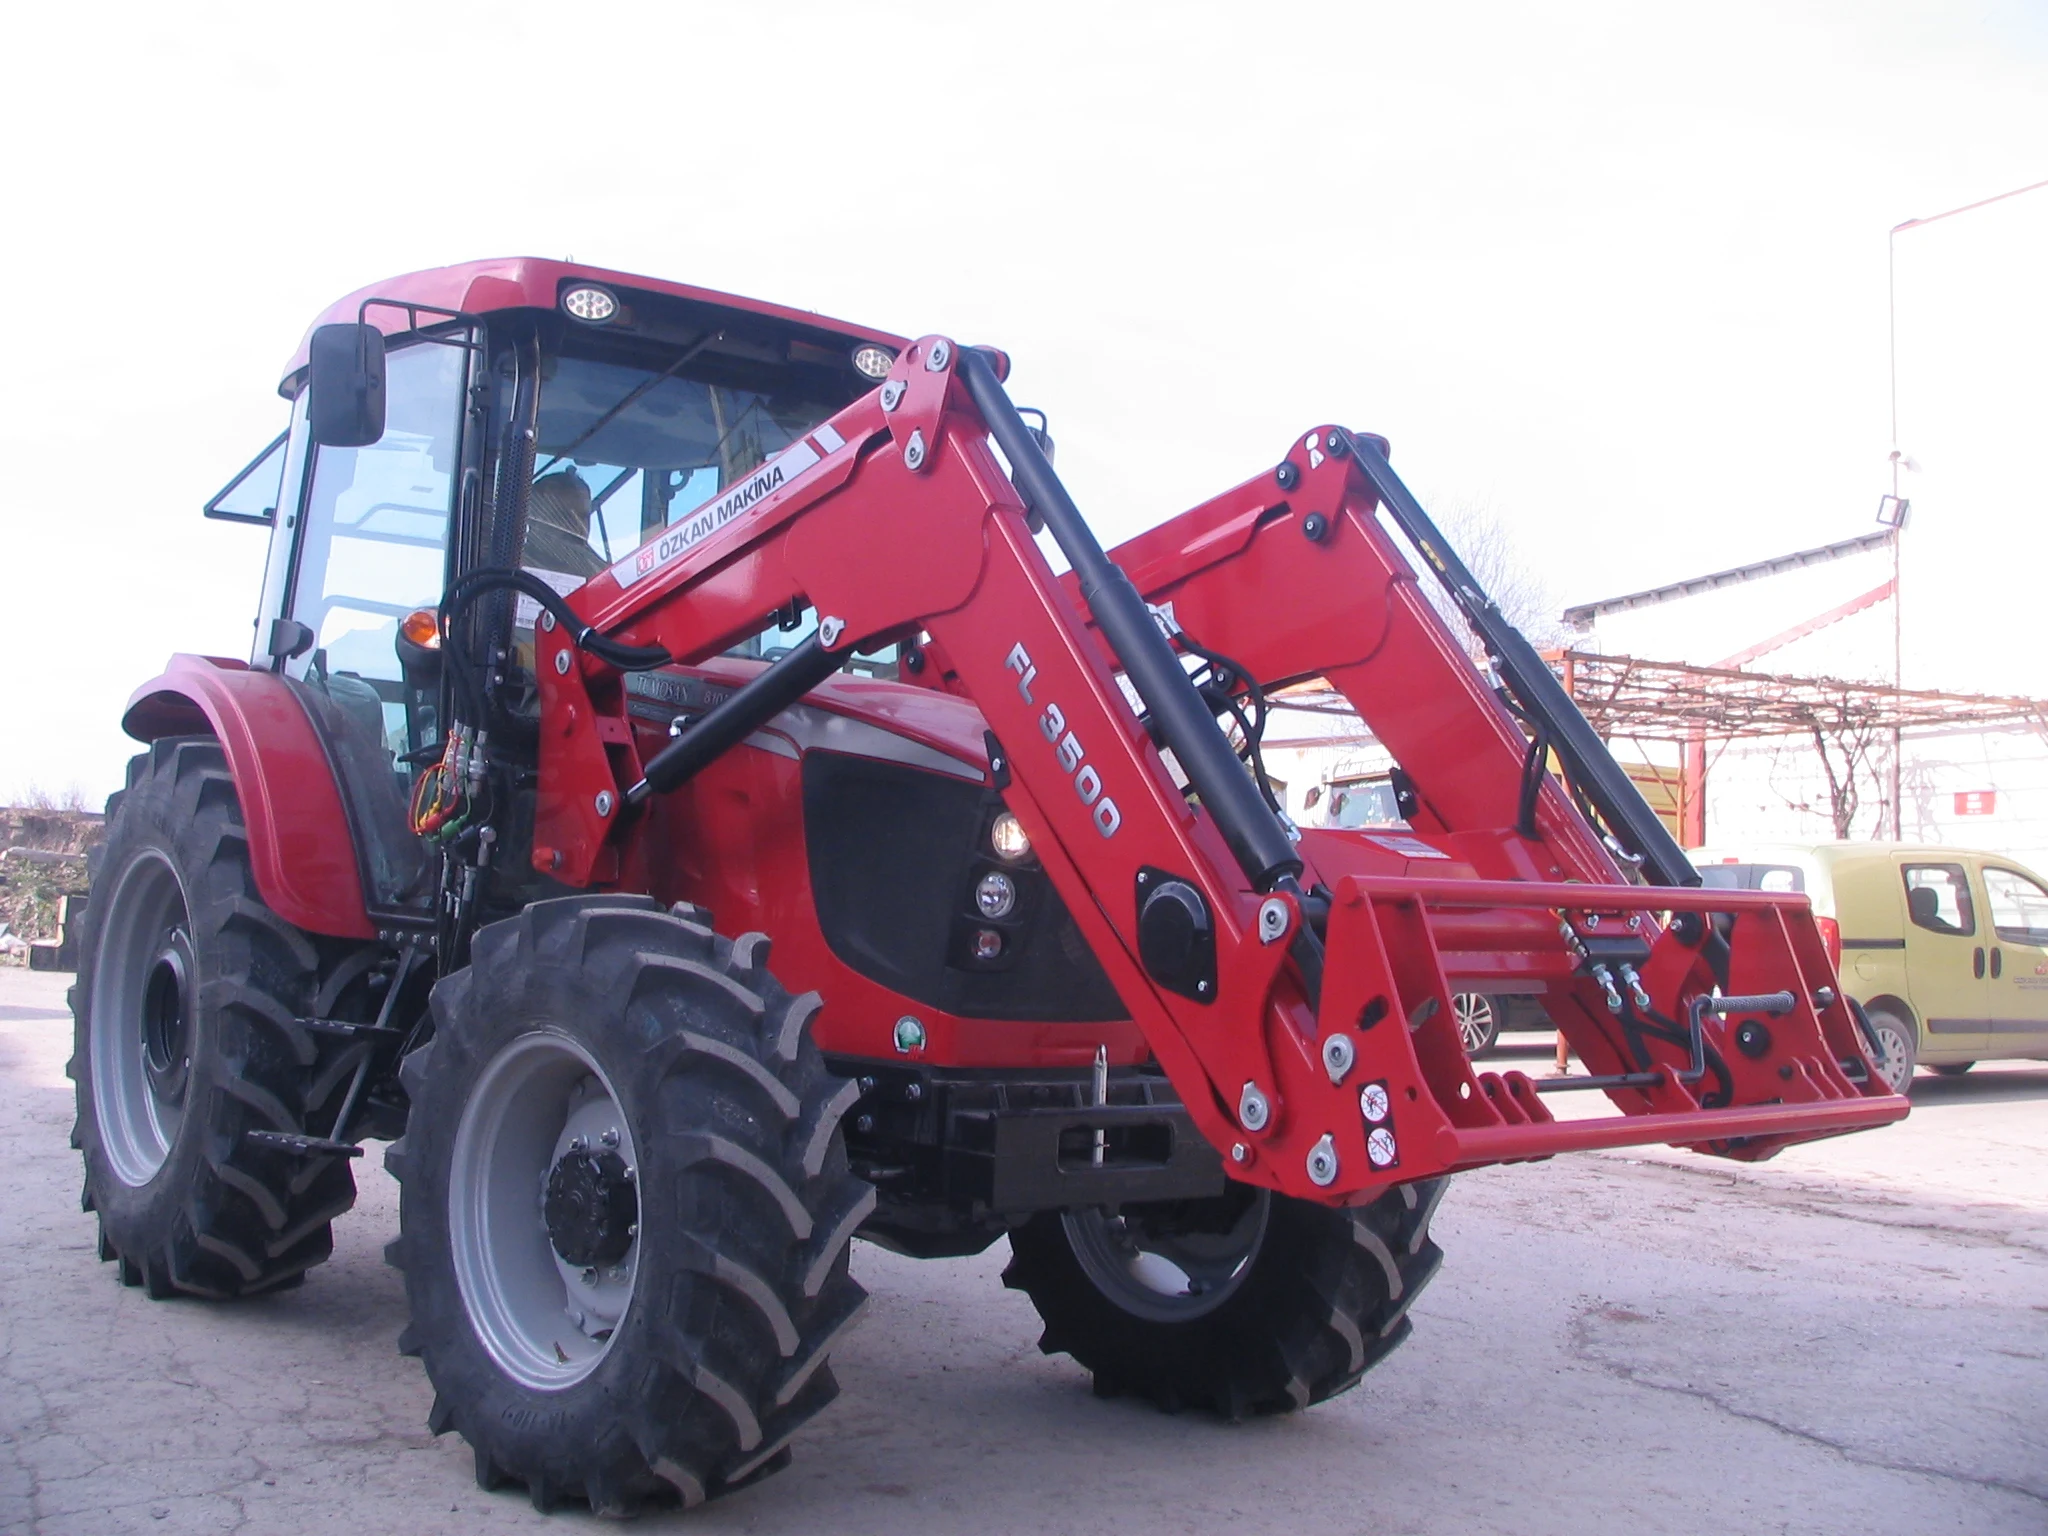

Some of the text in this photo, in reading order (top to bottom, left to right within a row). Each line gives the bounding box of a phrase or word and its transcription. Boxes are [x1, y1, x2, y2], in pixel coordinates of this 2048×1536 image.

[659, 466, 785, 560] ÖZKAN MAKİNA
[703, 690, 730, 704] 810
[1004, 642, 1122, 839] FL 3500
